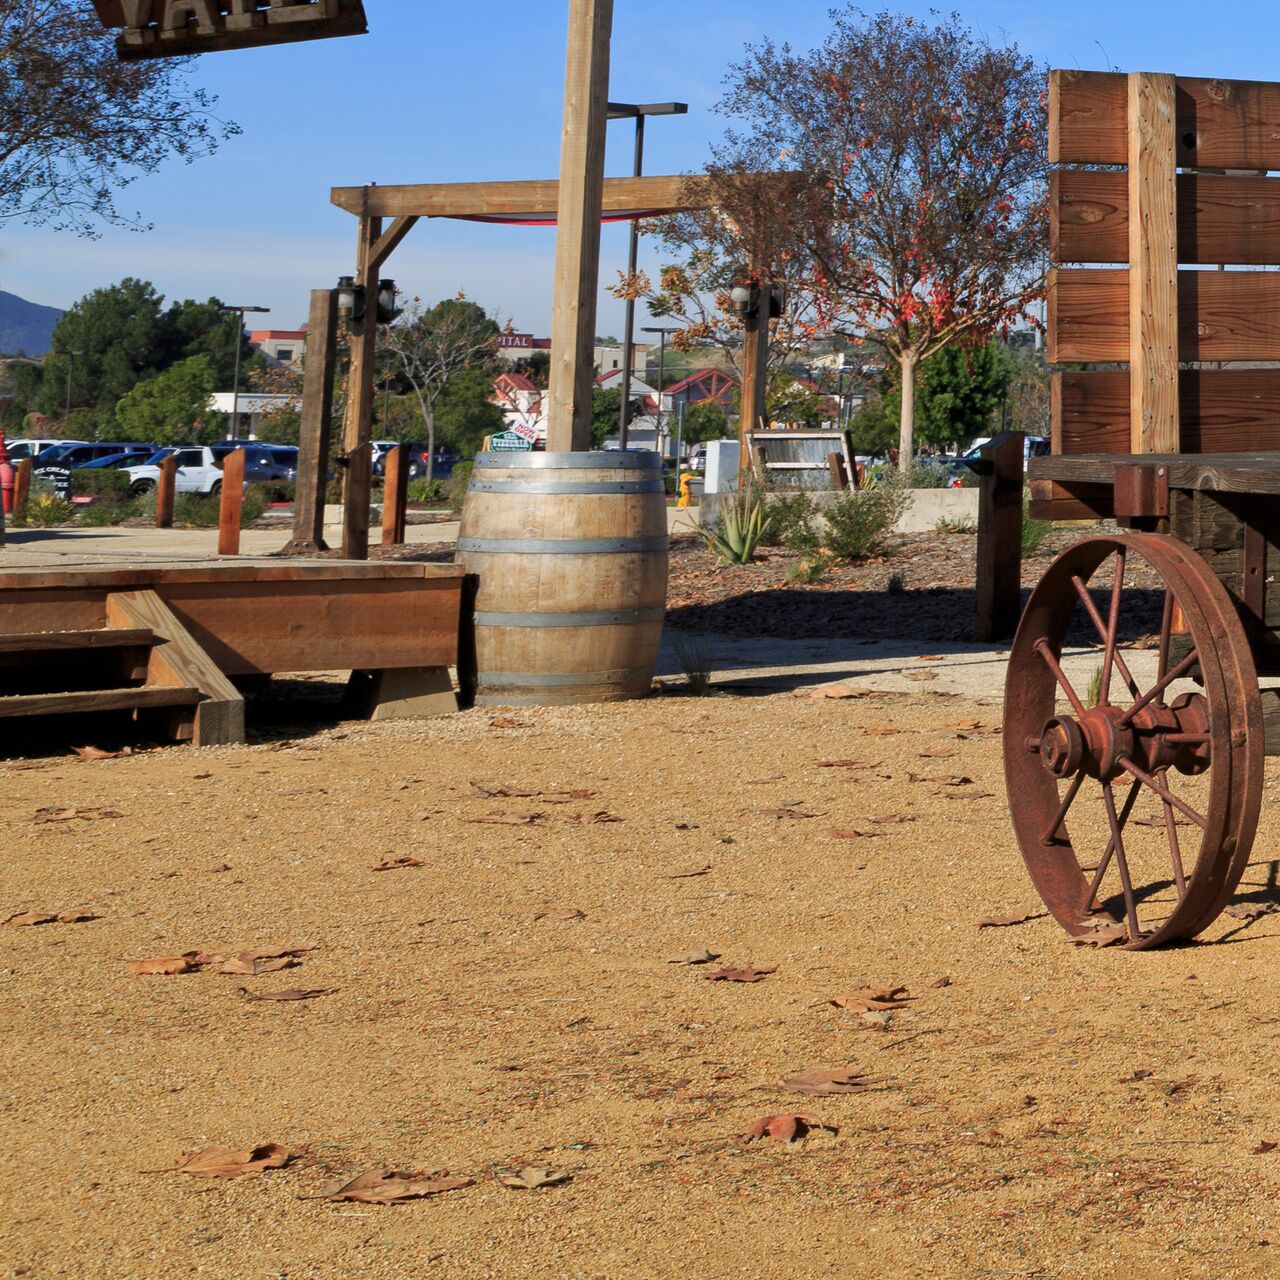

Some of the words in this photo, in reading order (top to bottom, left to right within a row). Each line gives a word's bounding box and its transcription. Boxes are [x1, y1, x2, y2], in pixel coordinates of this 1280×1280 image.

[514, 427, 534, 440] OPEN
[518, 424, 535, 434] NOW
[46, 467, 70, 475] CREAM
